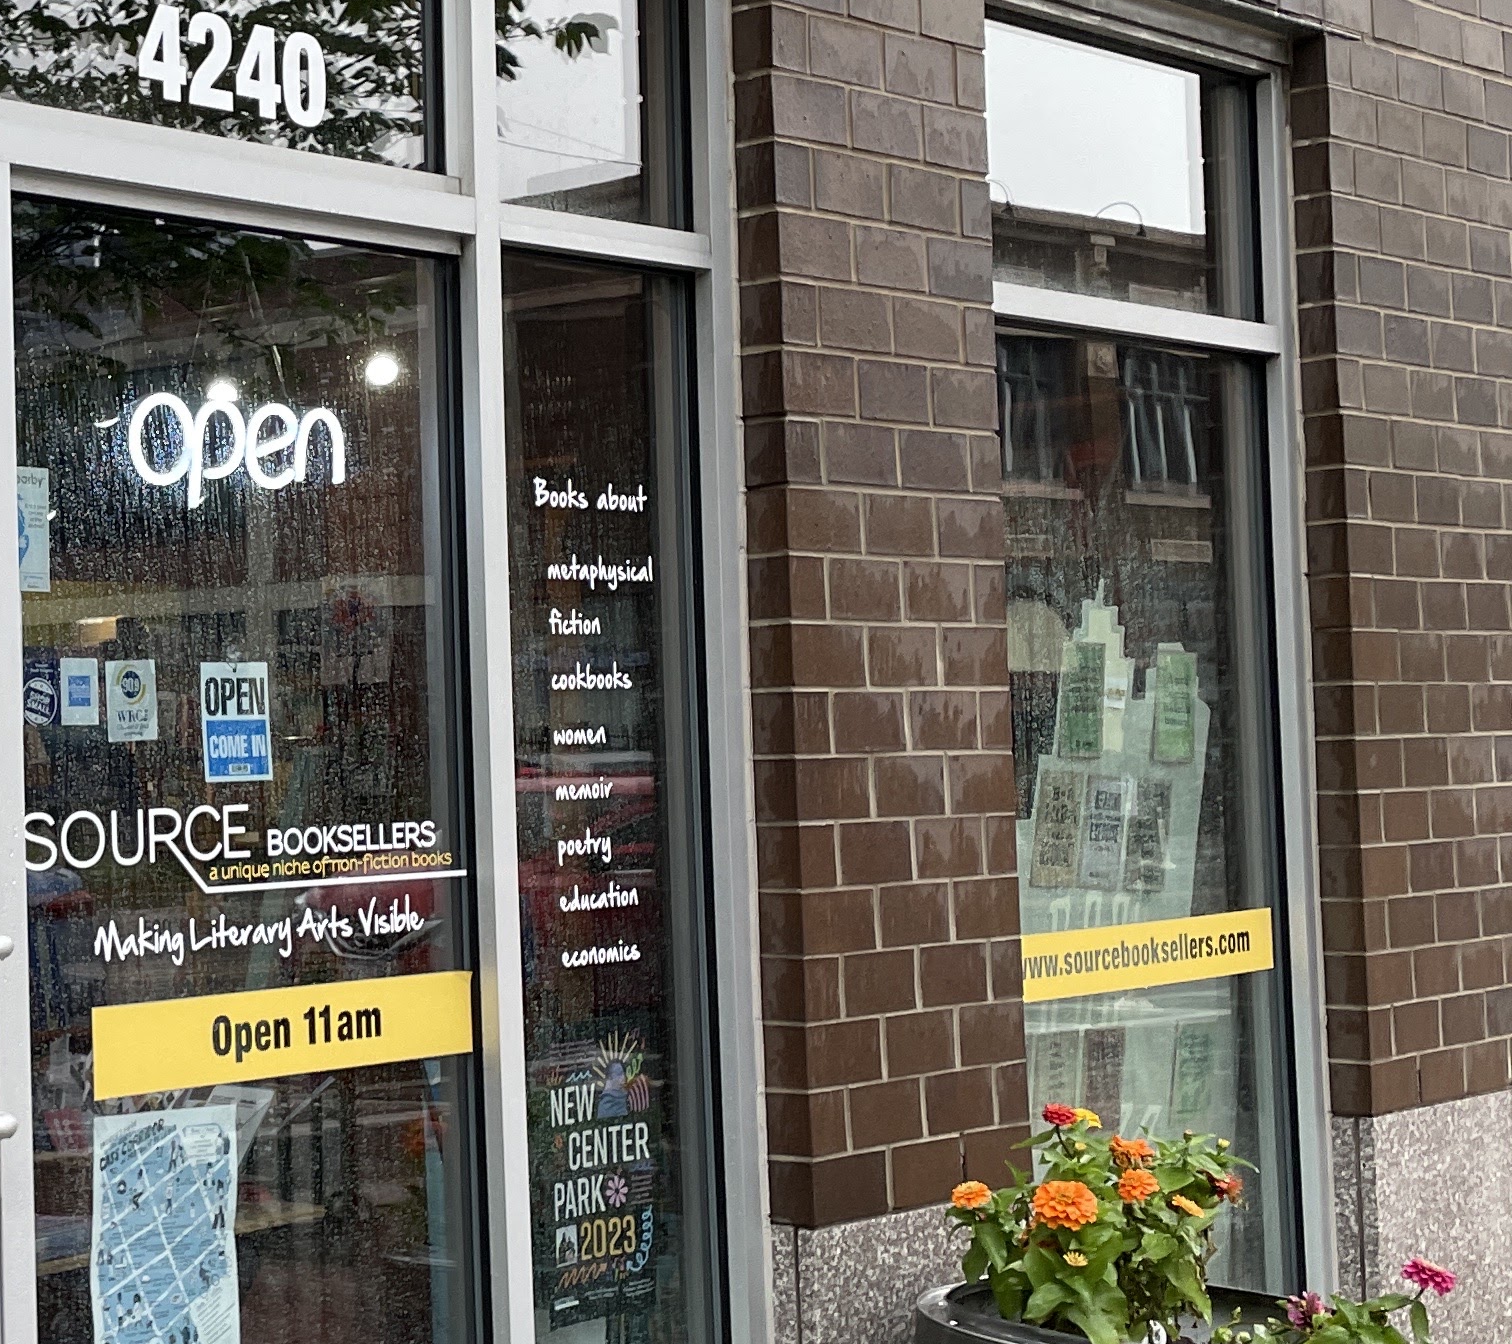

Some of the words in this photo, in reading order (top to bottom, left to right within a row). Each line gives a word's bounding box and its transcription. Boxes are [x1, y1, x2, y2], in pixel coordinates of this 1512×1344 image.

[138, 3, 326, 128] 4240
[534, 477, 589, 511] Books
[596, 482, 648, 513] about
[547, 554, 654, 591] metaphysical
[549, 608, 602, 636] fiction
[551, 660, 633, 692] cookbooks
[204, 676, 266, 717] OPEN
[209, 733, 249, 759] COME
[250, 733, 267, 758] IN
[553, 724, 607, 746] women
[555, 777, 614, 801] memoir
[25, 803, 251, 893] SOURCE
[267, 820, 437, 858] BOOKSELLERS
[209, 867, 219, 881] a
[221, 860, 270, 882] unique
[272, 855, 310, 876] niche
[312, 856, 332, 875] of
[332, 853, 409, 875] non-fiction
[411, 850, 453, 868] books
[557, 833, 612, 863] poetry
[559, 885, 639, 913] education
[94, 915, 185, 966] Making
[189, 912, 293, 959] Literary
[295, 902, 353, 942] Arts
[357, 893, 426, 937] Visible
[561, 940, 641, 969] economics
[212, 1014, 291, 1064] Open
[303, 1003, 383, 1047] 11am
[550, 1082, 596, 1129] NEW
[568, 1121, 650, 1171] CENTER
[554, 1174, 607, 1222] PARK
[580, 1214, 637, 1261] 2023
